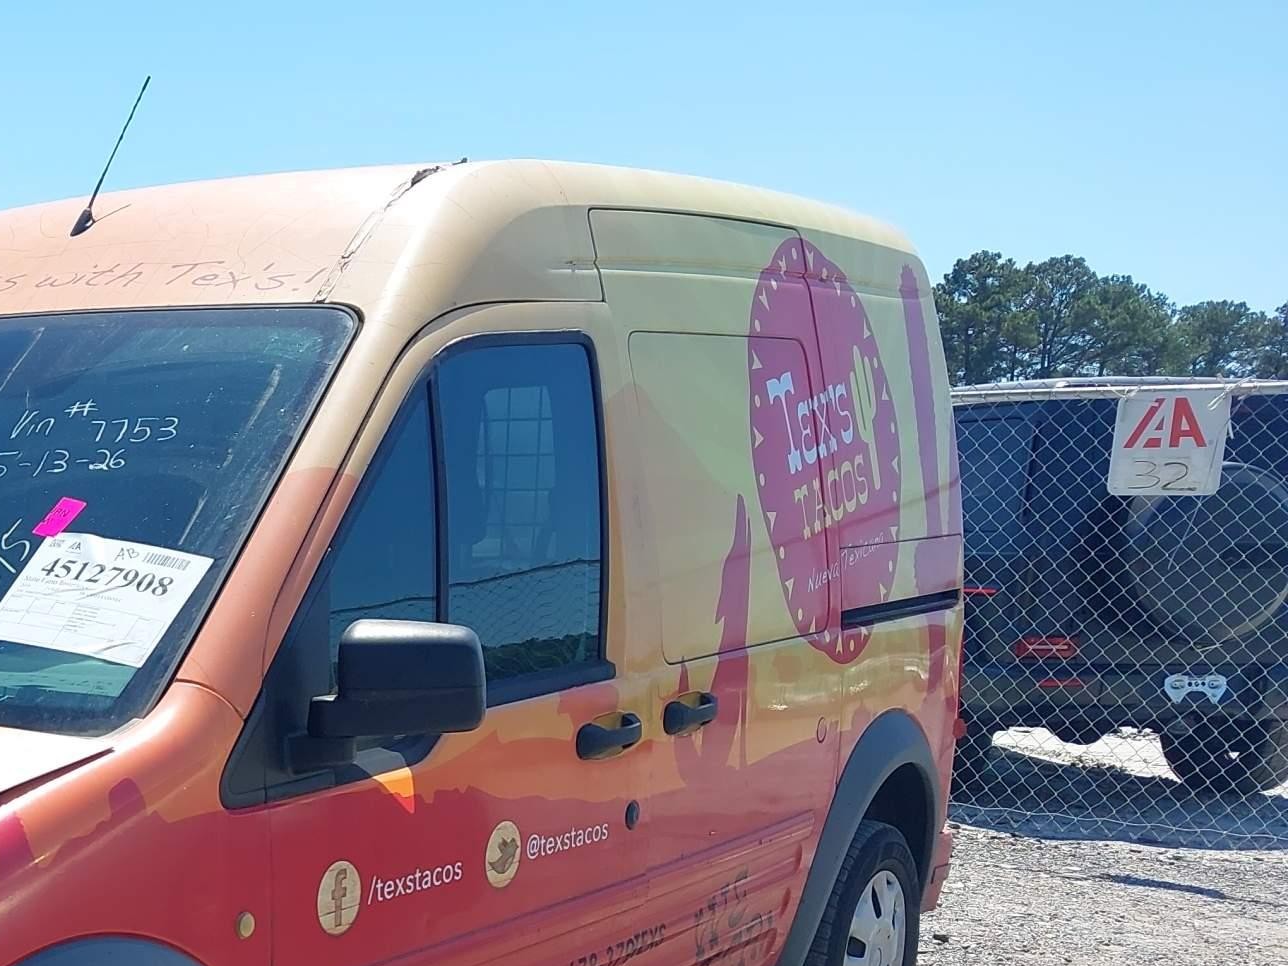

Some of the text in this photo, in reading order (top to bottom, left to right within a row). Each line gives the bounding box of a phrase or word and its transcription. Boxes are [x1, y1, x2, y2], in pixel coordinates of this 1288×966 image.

[34, 262, 144, 289] with
[64, 399, 99, 417] #
[91, 417, 179, 442] 7753
[1128, 460, 1197, 491] 32
[794, 454, 868, 540] TACOS
[41, 557, 175, 597] 45127908
[526, 822, 609, 860] @texstacos
[367, 860, 463, 906] /texstacos
